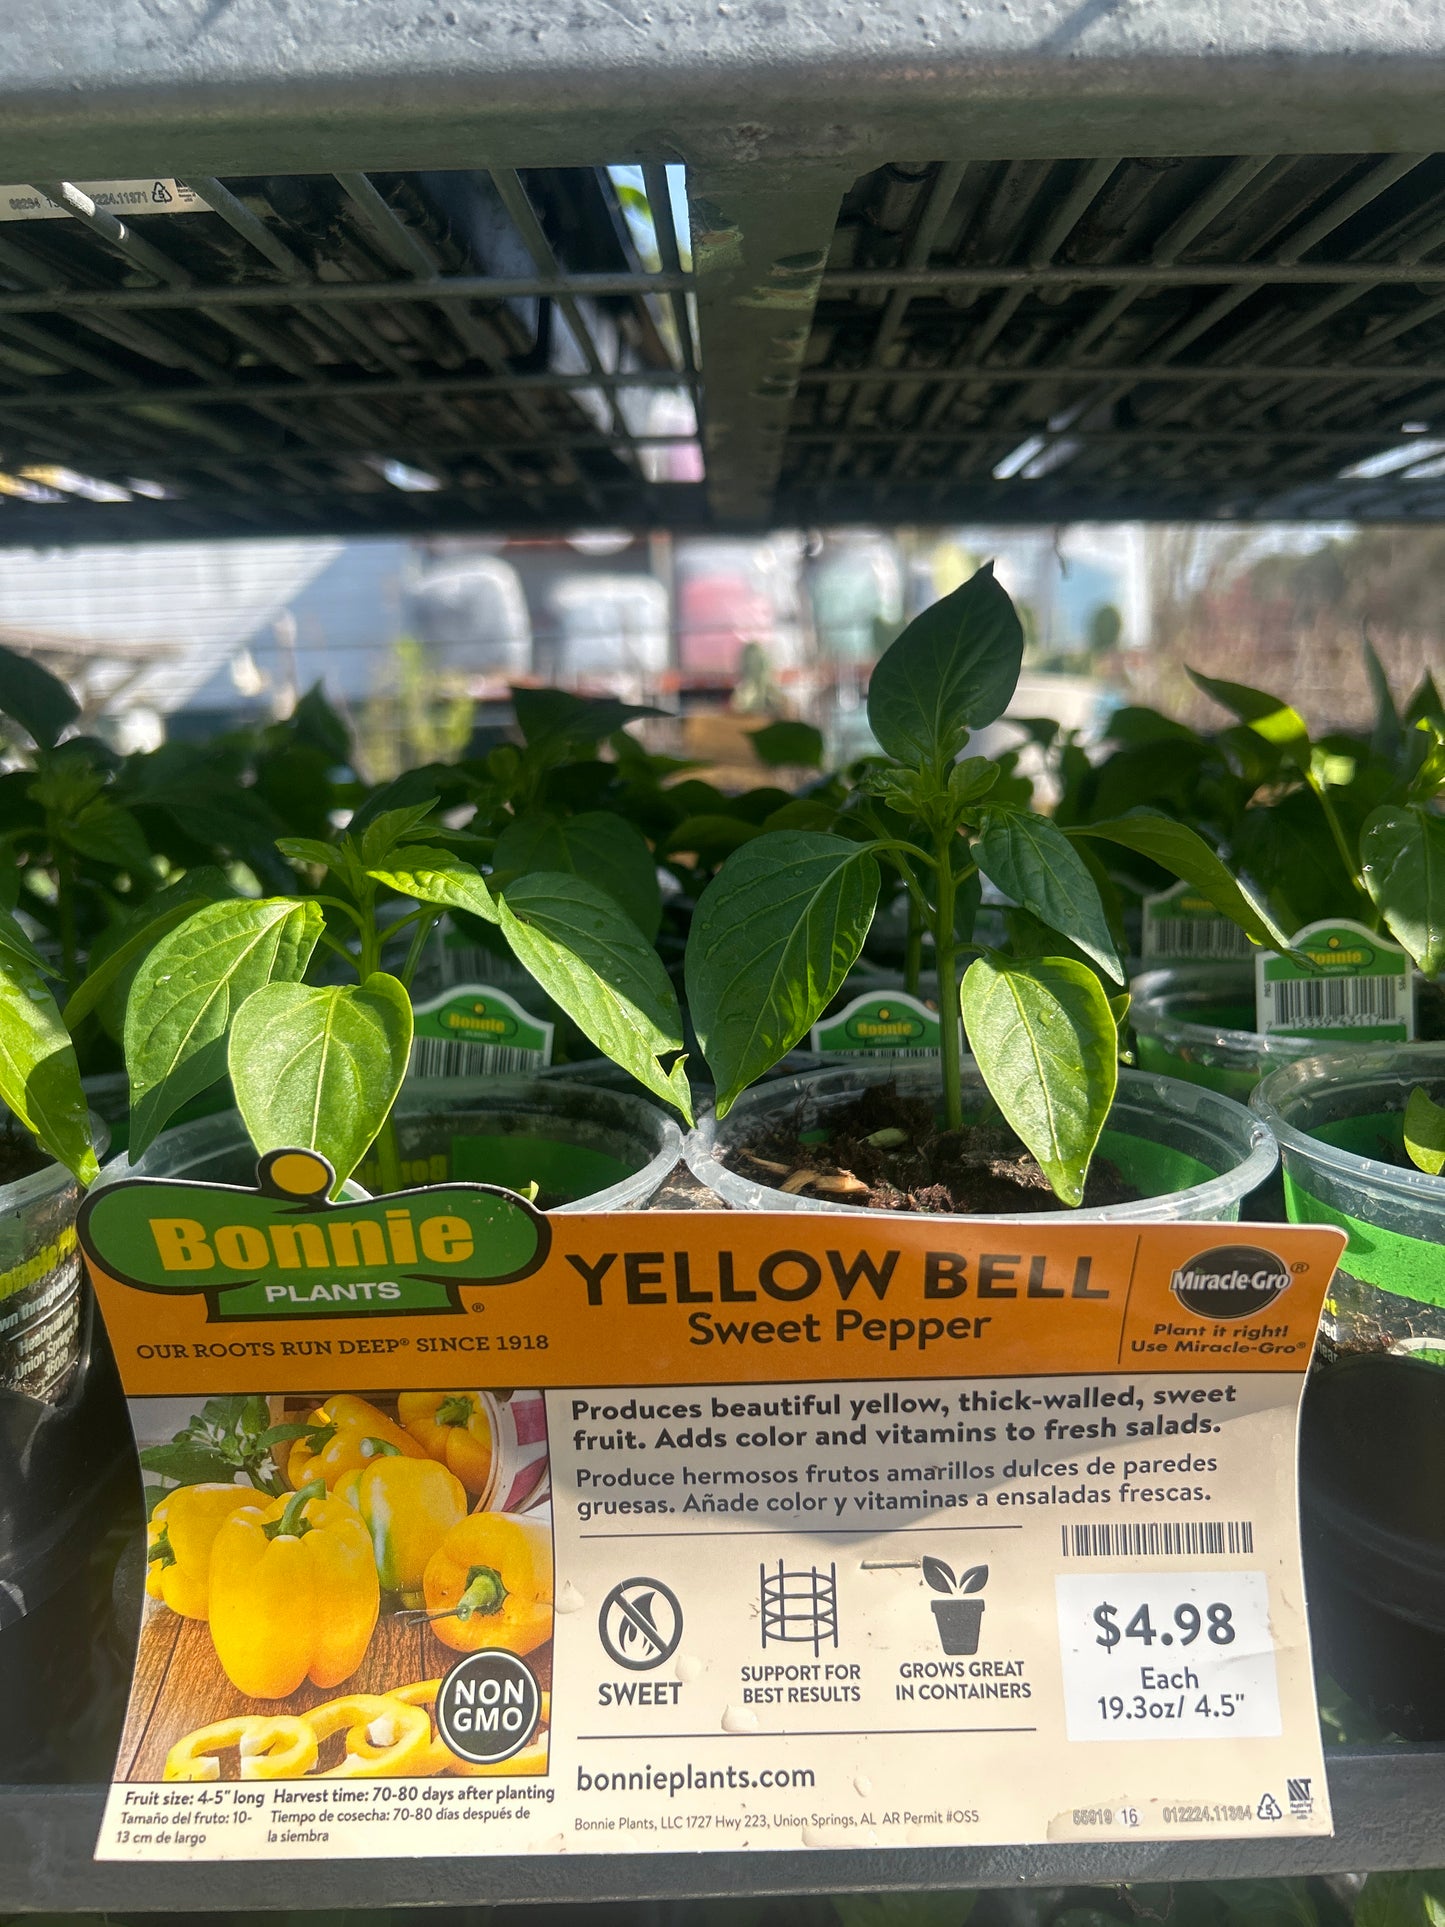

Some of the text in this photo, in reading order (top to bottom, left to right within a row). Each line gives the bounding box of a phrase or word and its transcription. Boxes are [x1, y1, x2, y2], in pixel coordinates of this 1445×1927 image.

[149, 1209, 475, 1271] Bonnie
[565, 1249, 1110, 1306] YELLOW BELL
[265, 1281, 401, 1303] PLANTS
[688, 1309, 992, 1351] Sweet Pepper
[1153, 1323, 1289, 1341] Plant it right!
[137, 1343, 188, 1360] OUR
[193, 1341, 275, 1358] ROOTS
[282, 1340, 331, 1356] RUN
[416, 1336, 490, 1353] SINCE
[497, 1335, 549, 1352] 1918
[1131, 1340, 1168, 1352] Use
[572, 1385, 1236, 1420] Produces beautiful yellow, thick-walled, sweet
[573, 1412, 1221, 1450] fruit. Adds color and vitamins to fresh salads.
[576, 1453, 1218, 1488] Produce hermosos frutos amarillos dulces de paredes
[577, 1482, 1212, 1521] gruesas. Añade color y vitaminas a ensaladas frescas.
[1093, 1601, 1236, 1654] $4.98
[741, 1664, 861, 1682] SUPPORT FOR
[899, 1660, 1025, 1678] GROWS GREAT
[1140, 1666, 1200, 1690] Each
[454, 1679, 525, 1705] NON
[598, 1682, 683, 1706] SWEET
[743, 1685, 861, 1704] BEST RESULTS
[896, 1682, 1032, 1701] IN CONTAINERS
[1098, 1695, 1185, 1720] 19.3oz/
[453, 1707, 523, 1732] GMO
[577, 1763, 816, 1797] bonnieplants.com
[124, 1791, 160, 1806] Fruit
[163, 1791, 194, 1806] size:
[233, 1790, 265, 1807] long
[273, 1784, 555, 1804] Harvest time: 70-80 days after planting
[120, 1810, 252, 1825] Tamaño del fruto: 10-
[270, 1806, 531, 1826] Tiempo de cosecha: 70-80 días después de
[574, 1817, 616, 1831] Bonnie
[618, 1816, 658, 1831] Plants,
[660, 1816, 683, 1830] LLC
[686, 1815, 712, 1829] 1727
[715, 1815, 742, 1831] Hwy
[744, 1814, 770, 1829] 223,
[773, 1813, 808, 1827] Union
[811, 1812, 858, 1829] Springs,
[860, 1812, 877, 1825] AL
[882, 1811, 900, 1825] AR
[903, 1810, 943, 1824] Permit
[1121, 1808, 1139, 1825] 16
[116, 1831, 207, 1847] 13 cm de largo
[267, 1829, 329, 1842] la siembra
